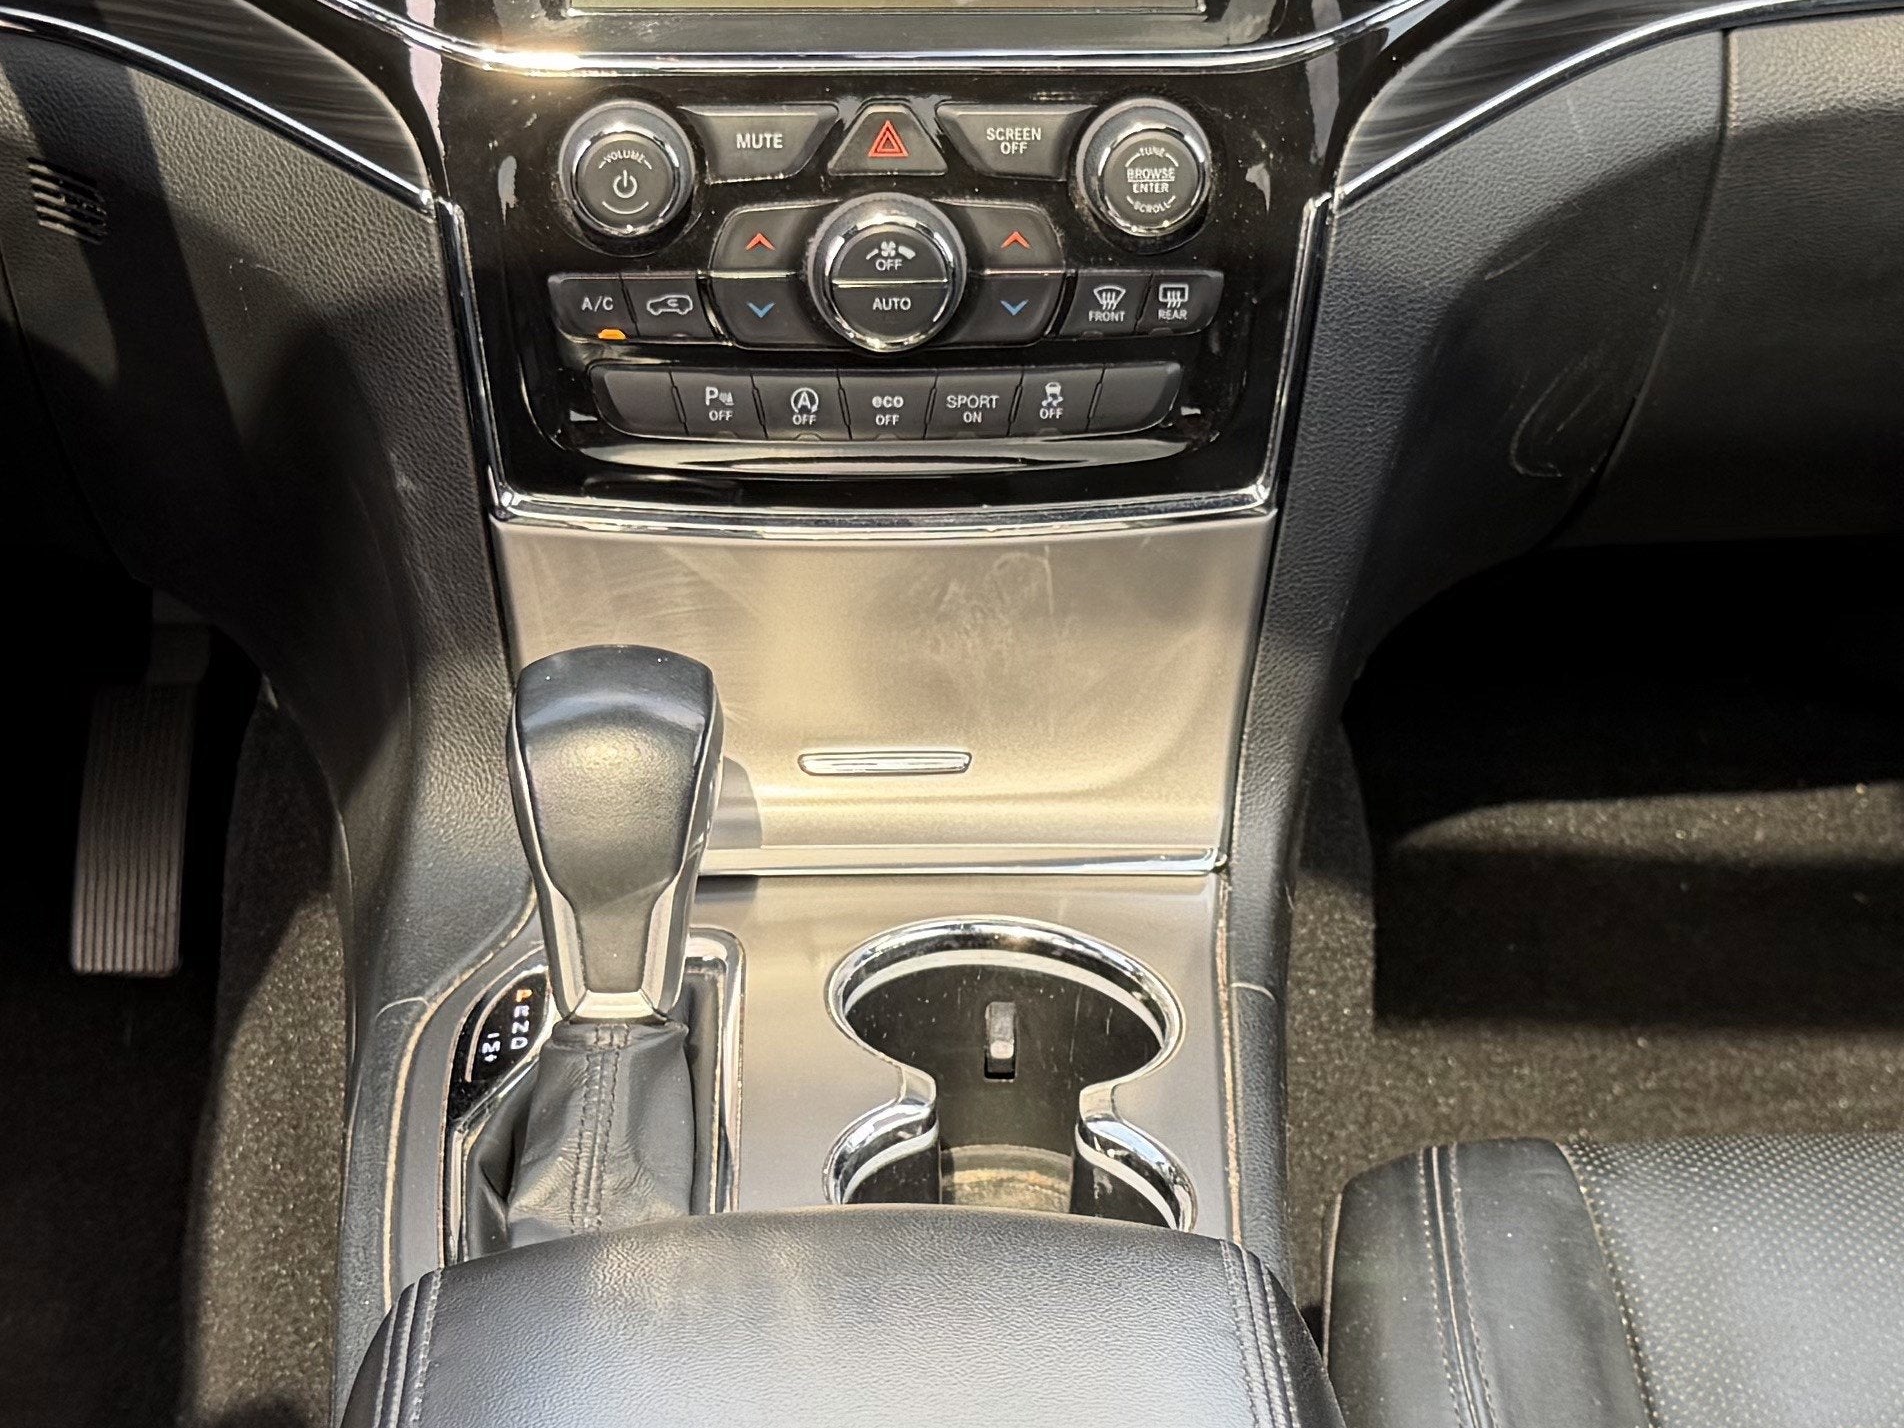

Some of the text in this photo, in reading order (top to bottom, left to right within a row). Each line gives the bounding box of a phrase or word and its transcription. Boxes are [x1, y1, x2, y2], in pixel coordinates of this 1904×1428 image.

[736, 132, 784, 150] MUTE
[986, 127, 1042, 142] SCREEN
[1000, 141, 1028, 156] OFF
[602, 149, 647, 165] VOLUME
[1126, 167, 1176, 181] BROWSE
[1132, 181, 1170, 194] ENTER
[876, 258, 903, 272] OFF
[581, 295, 615, 313] A/C
[872, 296, 912, 312] AUTO
[1088, 310, 1126, 323] FRONT
[1158, 309, 1188, 321] REAR
[946, 394, 1001, 410] SPORT
[708, 410, 734, 423] OFF
[792, 413, 817, 426] OFF
[875, 413, 901, 427] OFF
[963, 410, 983, 424] ON
[1039, 407, 1064, 420] OFF
[512, 1020, 529, 1034] N
[510, 1036, 528, 1050] D
